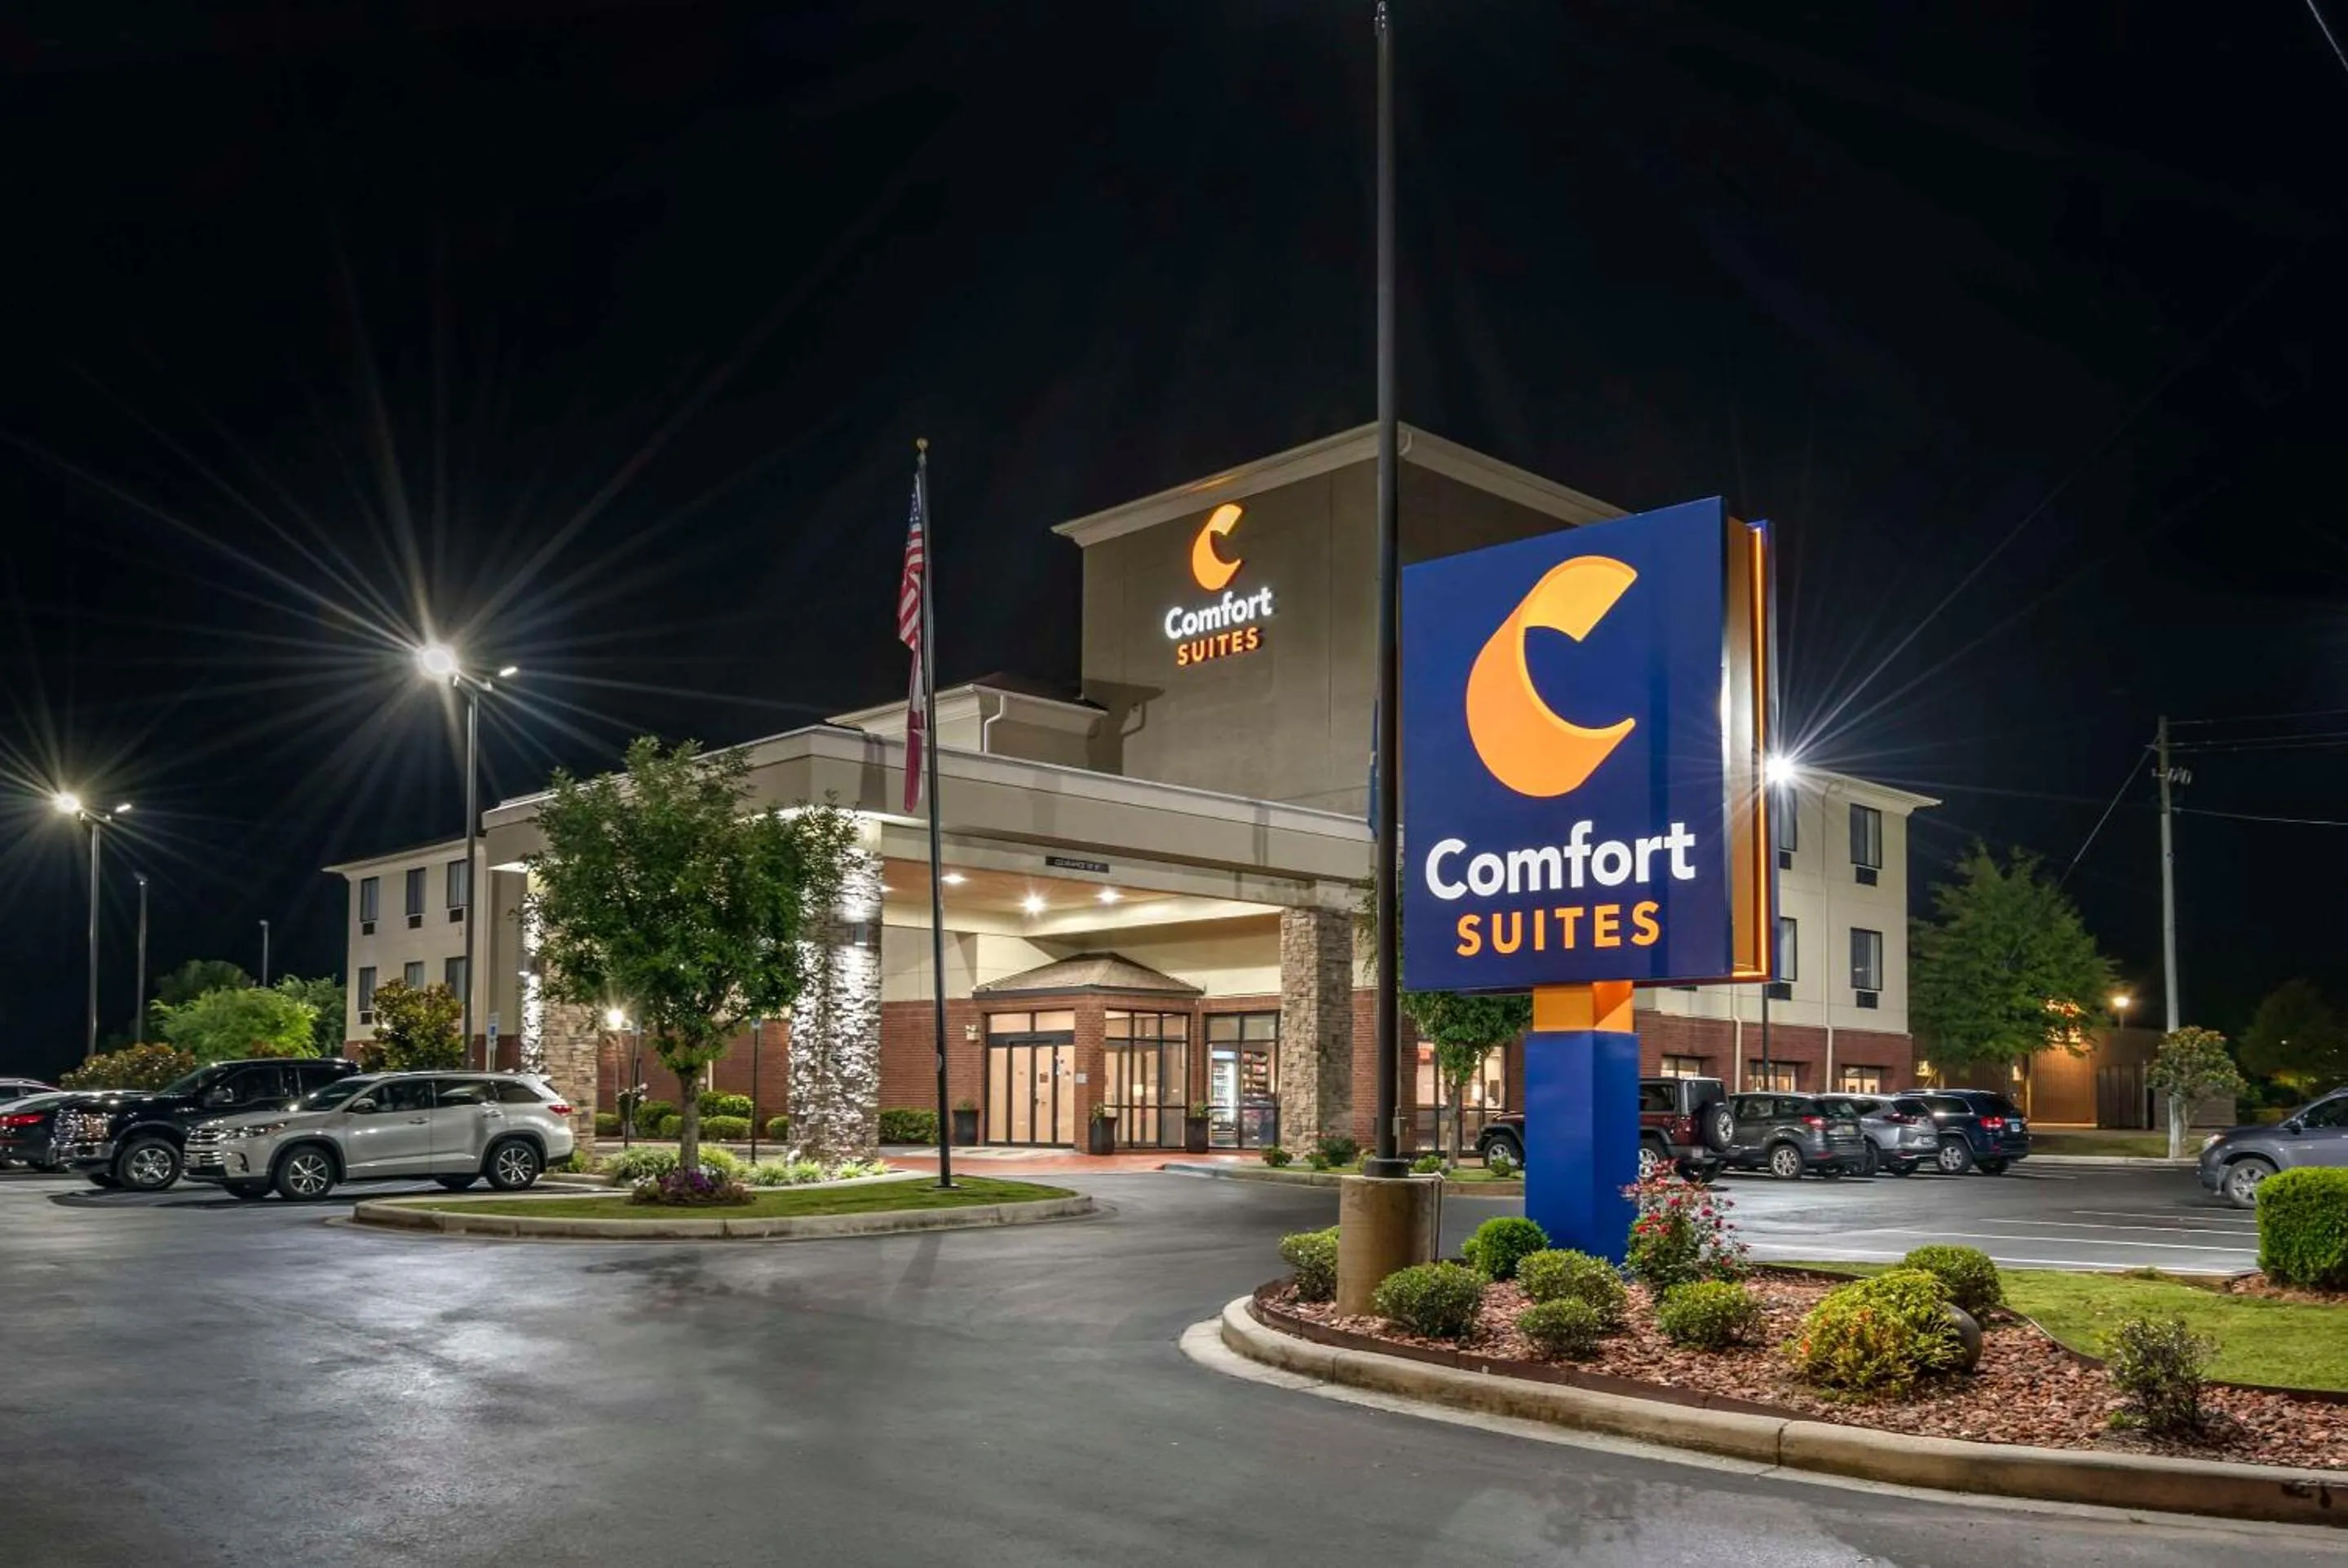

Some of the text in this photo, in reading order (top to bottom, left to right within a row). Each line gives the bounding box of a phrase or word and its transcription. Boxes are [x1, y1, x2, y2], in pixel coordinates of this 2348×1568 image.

[1165, 586, 1273, 639] Comfort
[1177, 627, 1259, 666] SUITES
[1426, 819, 1696, 900] Comfort
[1456, 900, 1660, 957] SUITES
